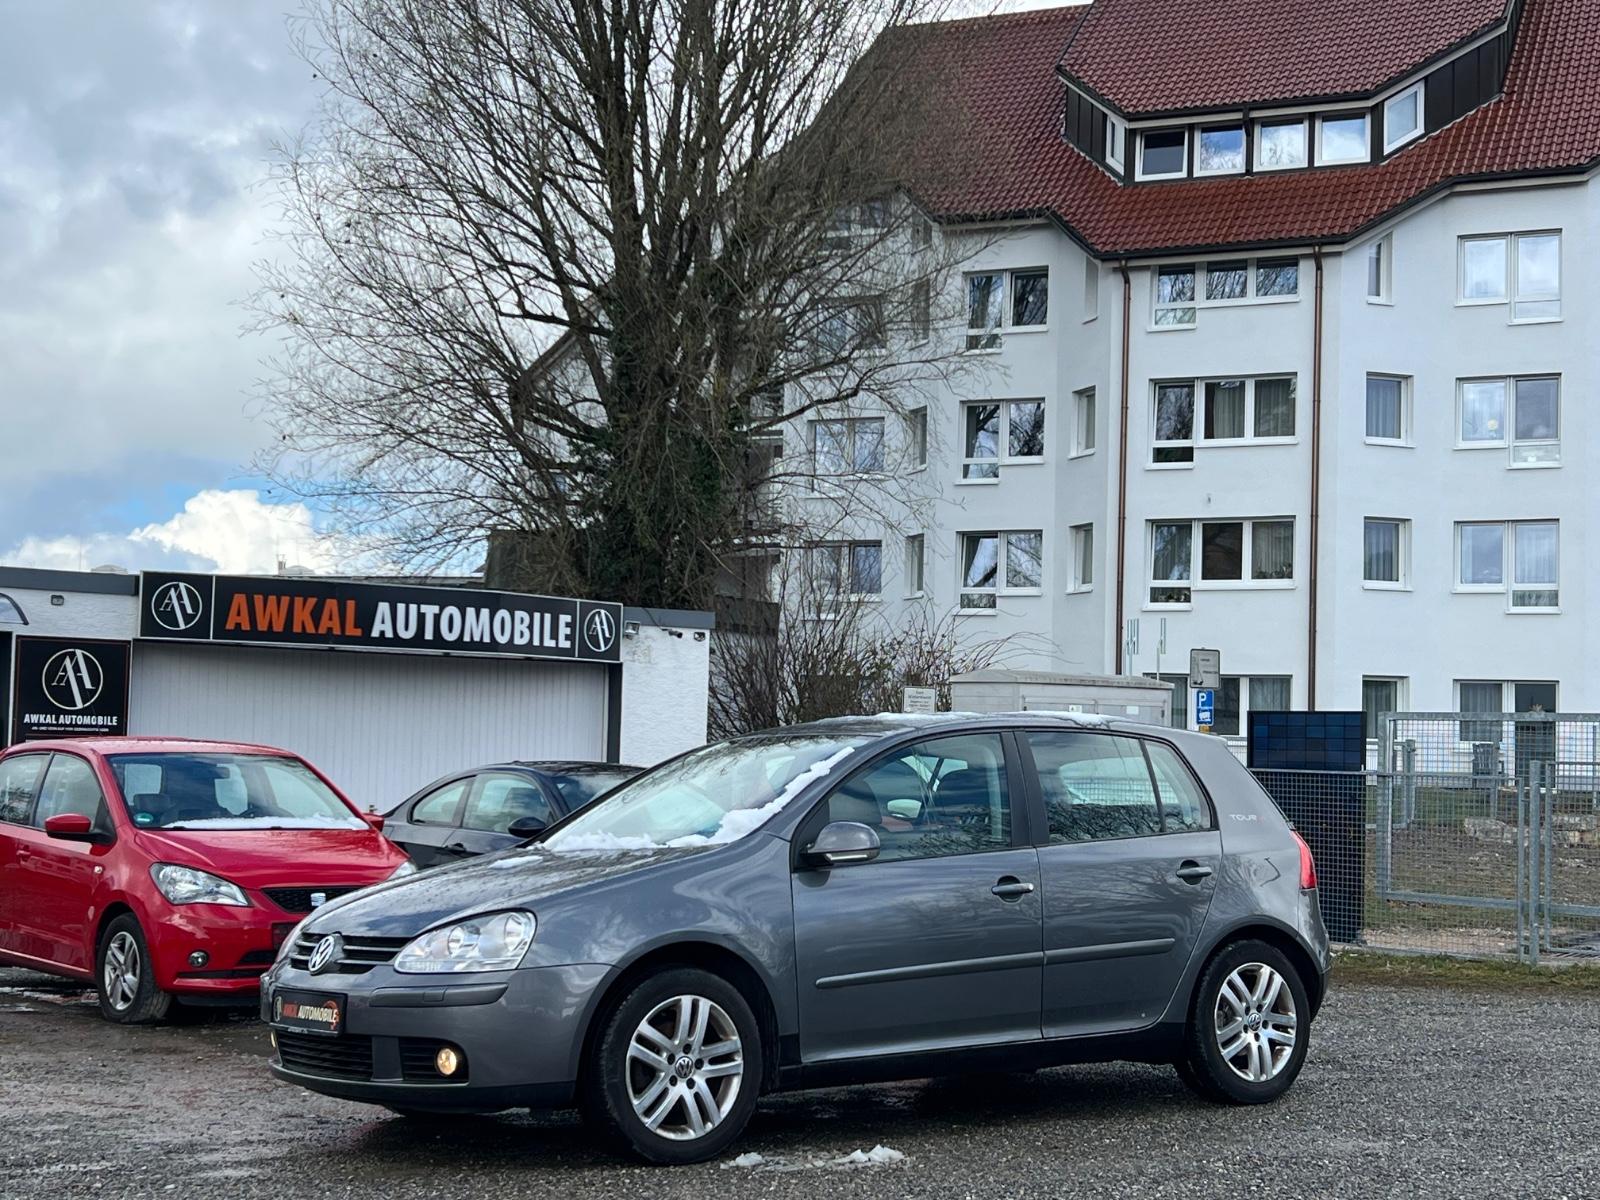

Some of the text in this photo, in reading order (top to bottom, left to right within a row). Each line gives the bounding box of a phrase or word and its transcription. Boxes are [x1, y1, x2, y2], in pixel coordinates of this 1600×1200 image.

[225, 593, 572, 649] AWKAL AUTOMOBILE
[1199, 692, 1207, 708] P
[24, 714, 117, 725] AWKAL AUTOMOBILE
[298, 1005, 338, 1022] AUTOMOBILE
